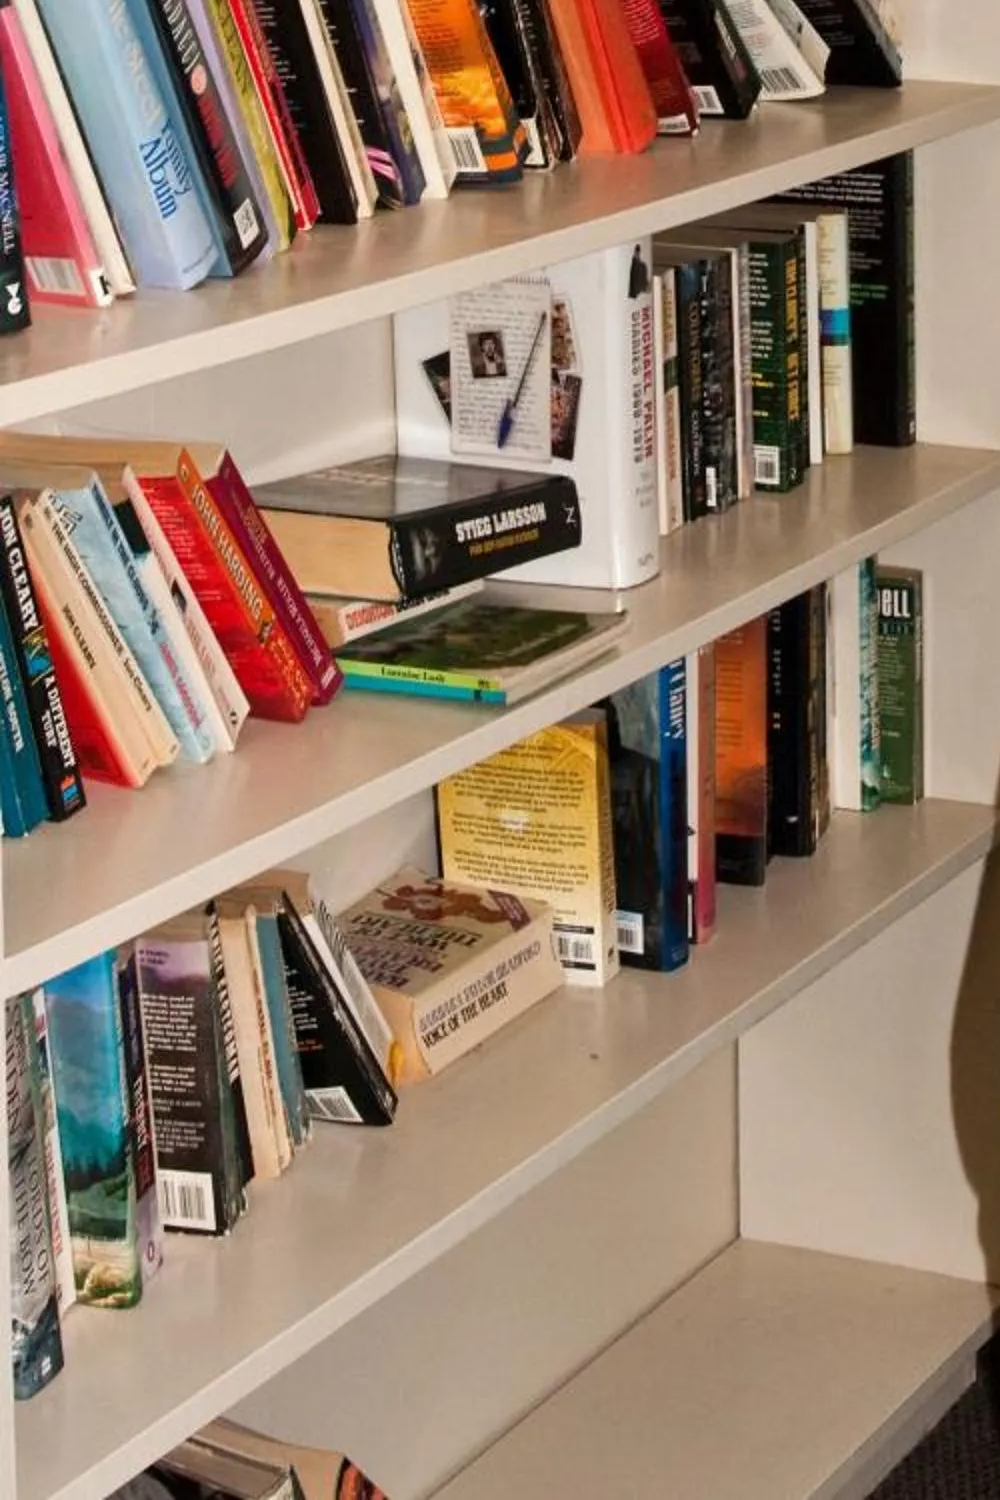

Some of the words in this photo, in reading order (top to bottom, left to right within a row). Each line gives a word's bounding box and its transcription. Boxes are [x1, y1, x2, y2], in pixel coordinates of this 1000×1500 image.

[139, 136, 180, 219] Album
[157, 118, 196, 196] Family
[641, 306, 655, 393] MICHAEL
[642, 402, 654, 458] PALIN
[0, 503, 19, 546] JON
[190, 483, 218, 530] JOHN
[210, 532, 264, 620] HARDING
[454, 515, 493, 543] STIEG
[492, 501, 548, 534] LARSSON
[9, 546, 39, 633] CLEARY
[51, 521, 67, 545] THE
[64, 546, 83, 573] HIGH
[77, 573, 125, 654] COMMISSIONER
[131, 678, 153, 712] Cleary
[61, 604, 75, 623] JON
[70, 625, 97, 669] CLEARY
[39, 709, 58, 749] TURF
[48, 688, 76, 768] DIFFERENT
[664, 673, 688, 741] Clancy
[420, 1022, 449, 1051] VOICE
[447, 1015, 461, 1033] OF
[460, 1004, 479, 1024] THE
[478, 980, 509, 1015] HEART
[15, 1178, 34, 1232] THE
[28, 1157, 49, 1244] LORDS
[18, 1232, 38, 1297] BOW
[36, 1247, 52, 1287] OF
